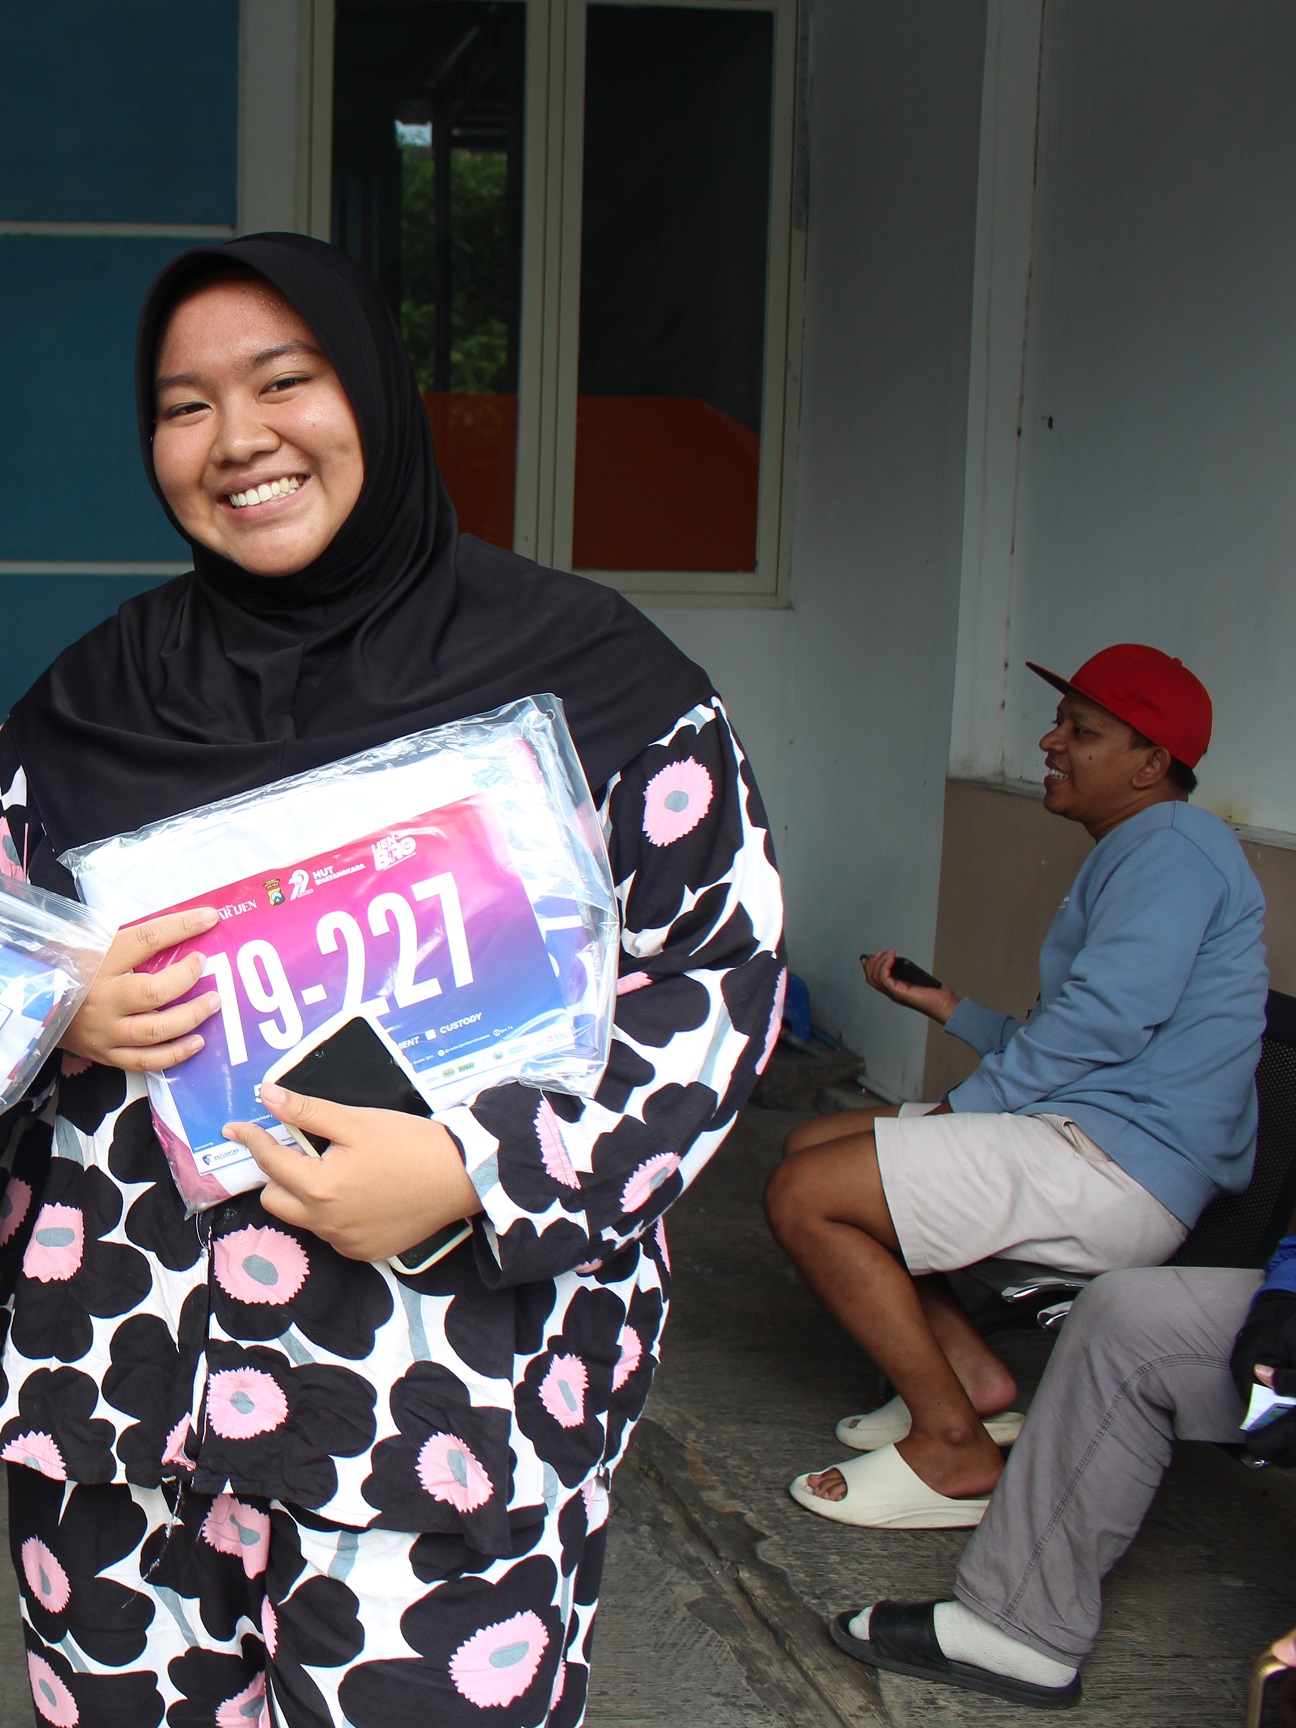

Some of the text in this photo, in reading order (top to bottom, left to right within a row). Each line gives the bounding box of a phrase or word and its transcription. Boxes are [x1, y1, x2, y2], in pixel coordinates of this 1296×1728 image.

[371, 834, 396, 852] IJEN
[313, 866, 333, 879] HUT
[315, 864, 365, 885] BHAYANGKARA
[232, 900, 257, 915] IJEN
[199, 872, 473, 1066] 79-227
[440, 1012, 481, 1033] CUSTODY
